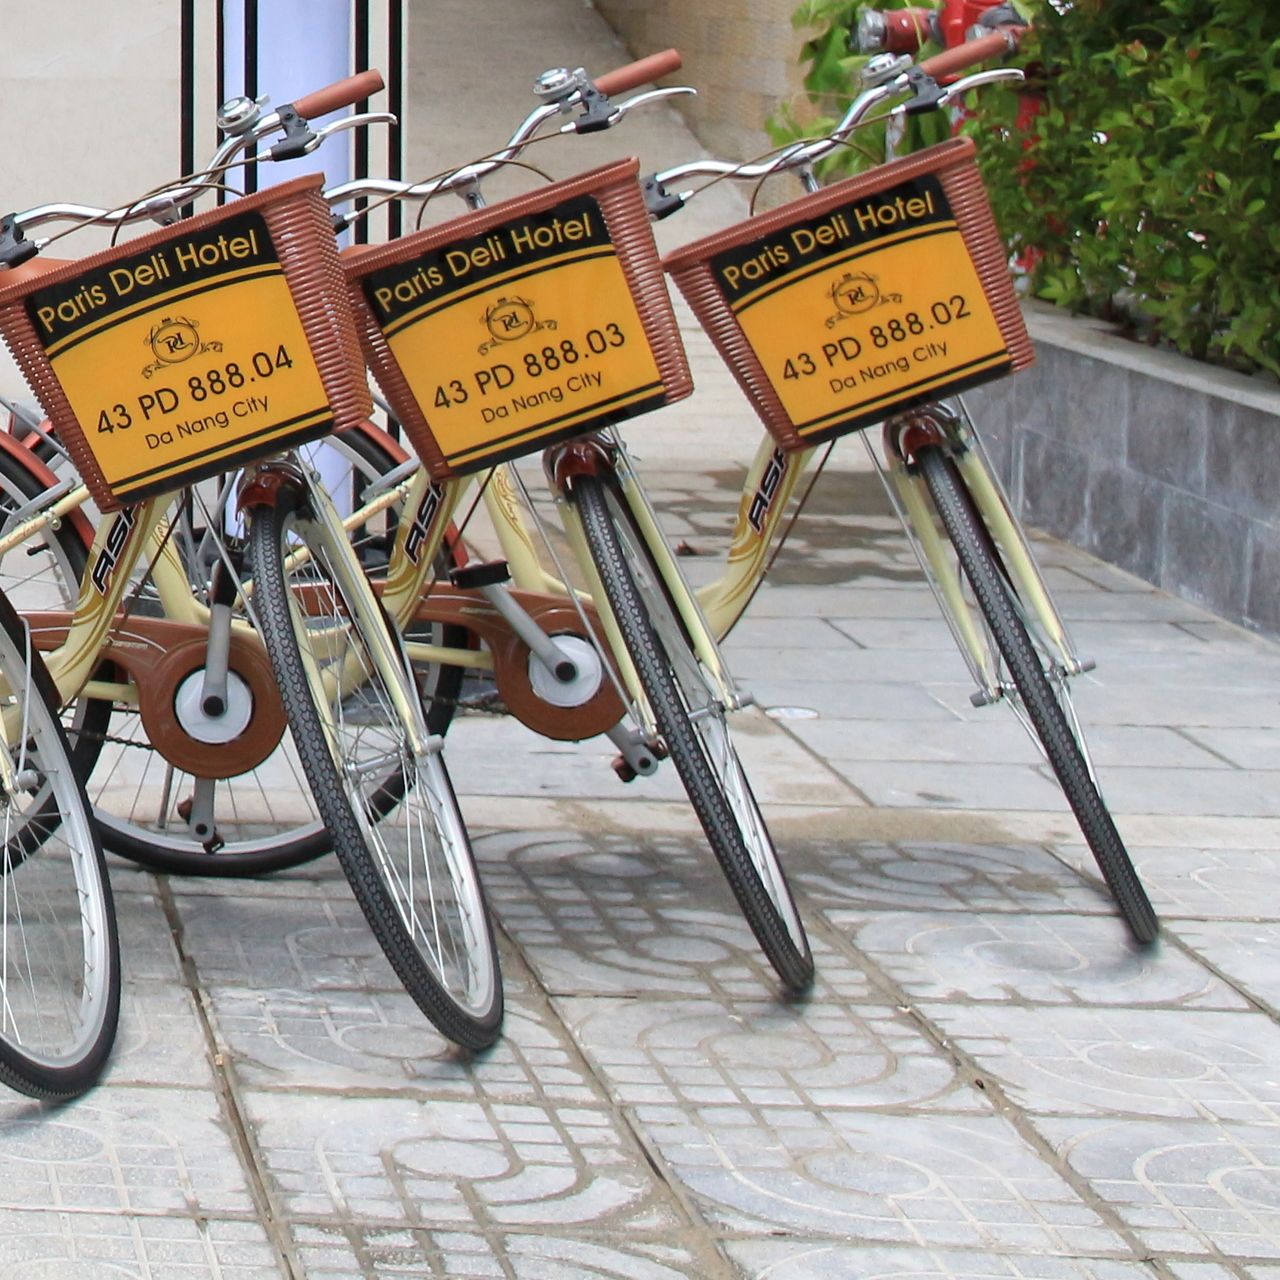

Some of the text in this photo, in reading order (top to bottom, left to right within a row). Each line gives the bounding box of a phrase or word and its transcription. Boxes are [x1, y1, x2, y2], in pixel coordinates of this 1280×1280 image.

[37, 230, 257, 332] Paris Deli Hotel
[374, 214, 590, 311] Paris Deli Hotel
[723, 192, 933, 288] Paris Deli Hotel
[435, 323, 626, 408] 43 PD 888.03
[784, 295, 970, 379] 43 PD 888.02
[830, 341, 946, 393] Da Nang City
[98, 344, 293, 433] 43 PD 888.04
[145, 396, 267, 449] Da Nang City
[481, 372, 601, 423] Da Nang City
